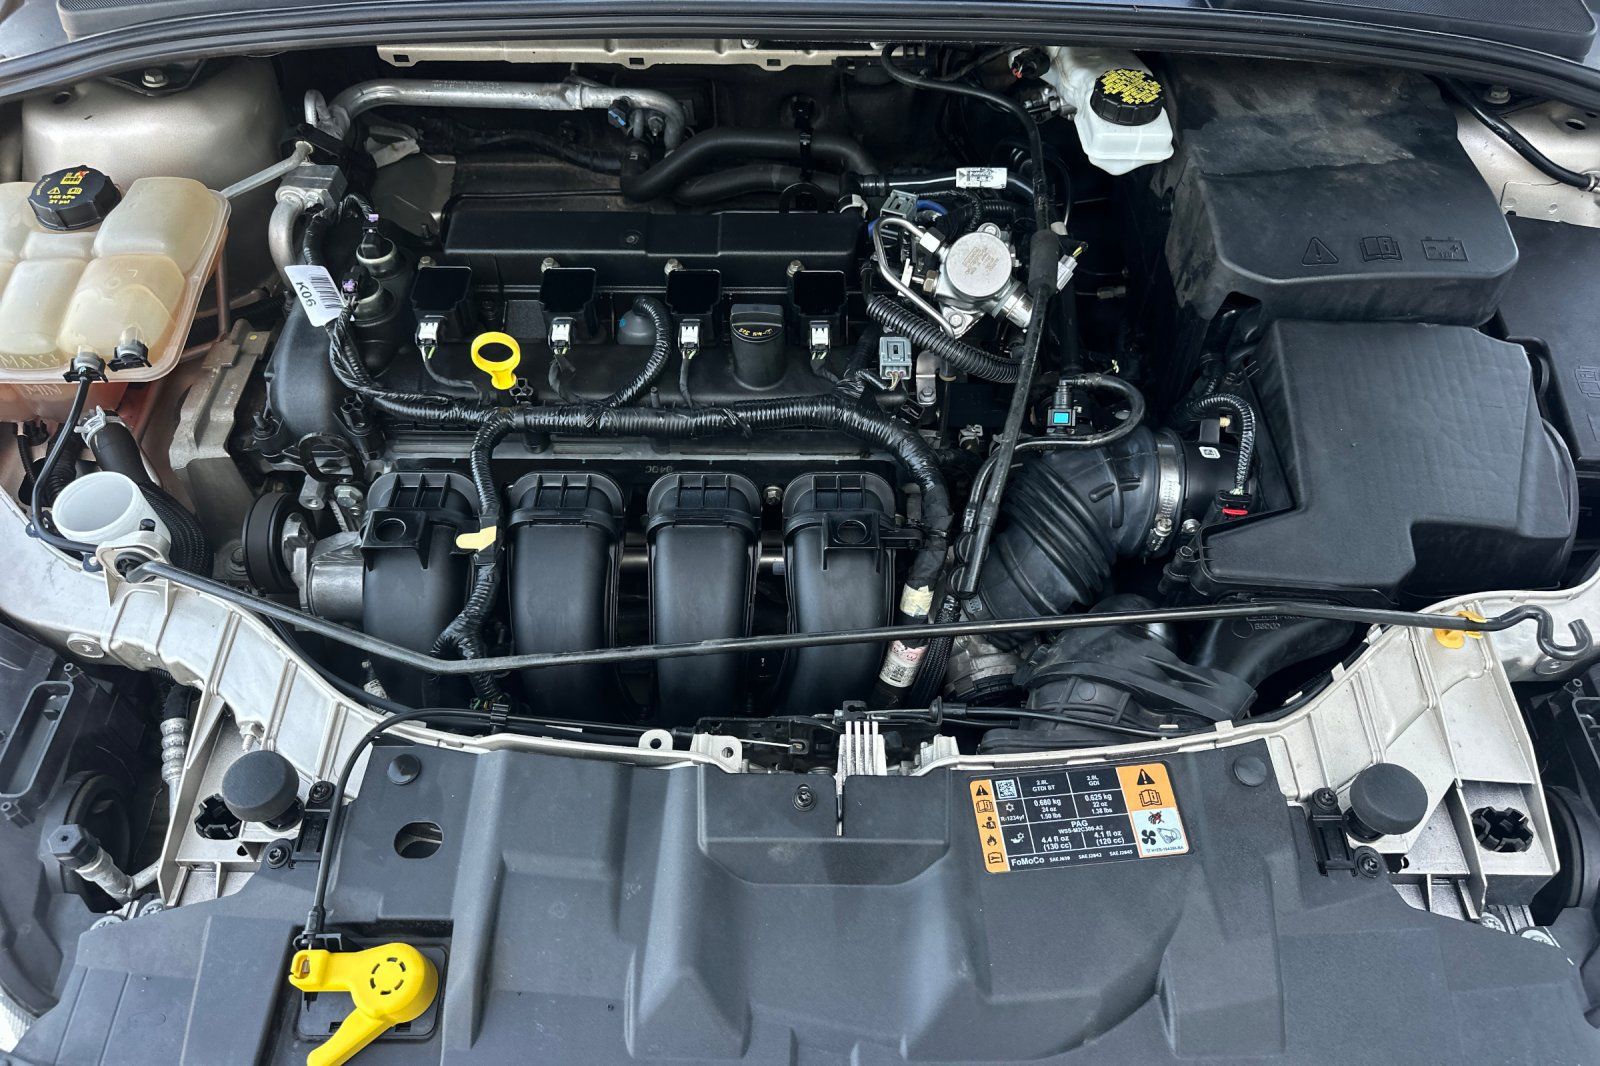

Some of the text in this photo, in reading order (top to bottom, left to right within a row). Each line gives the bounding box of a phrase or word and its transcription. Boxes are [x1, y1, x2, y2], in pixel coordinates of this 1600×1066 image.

[296, 281, 316, 307] K06
[1084, 793, 1113, 802] 0.625 kg
[1052, 798, 1062, 807] kg
[1052, 812, 1061, 820] lbs
[1070, 820, 1089, 828] PAG
[1041, 836, 1052, 844] 4.4
[1096, 837, 1125, 846] (120 cc)
[1043, 841, 1072, 852] (130 cc)
[1010, 856, 1045, 867] FoMoCo
